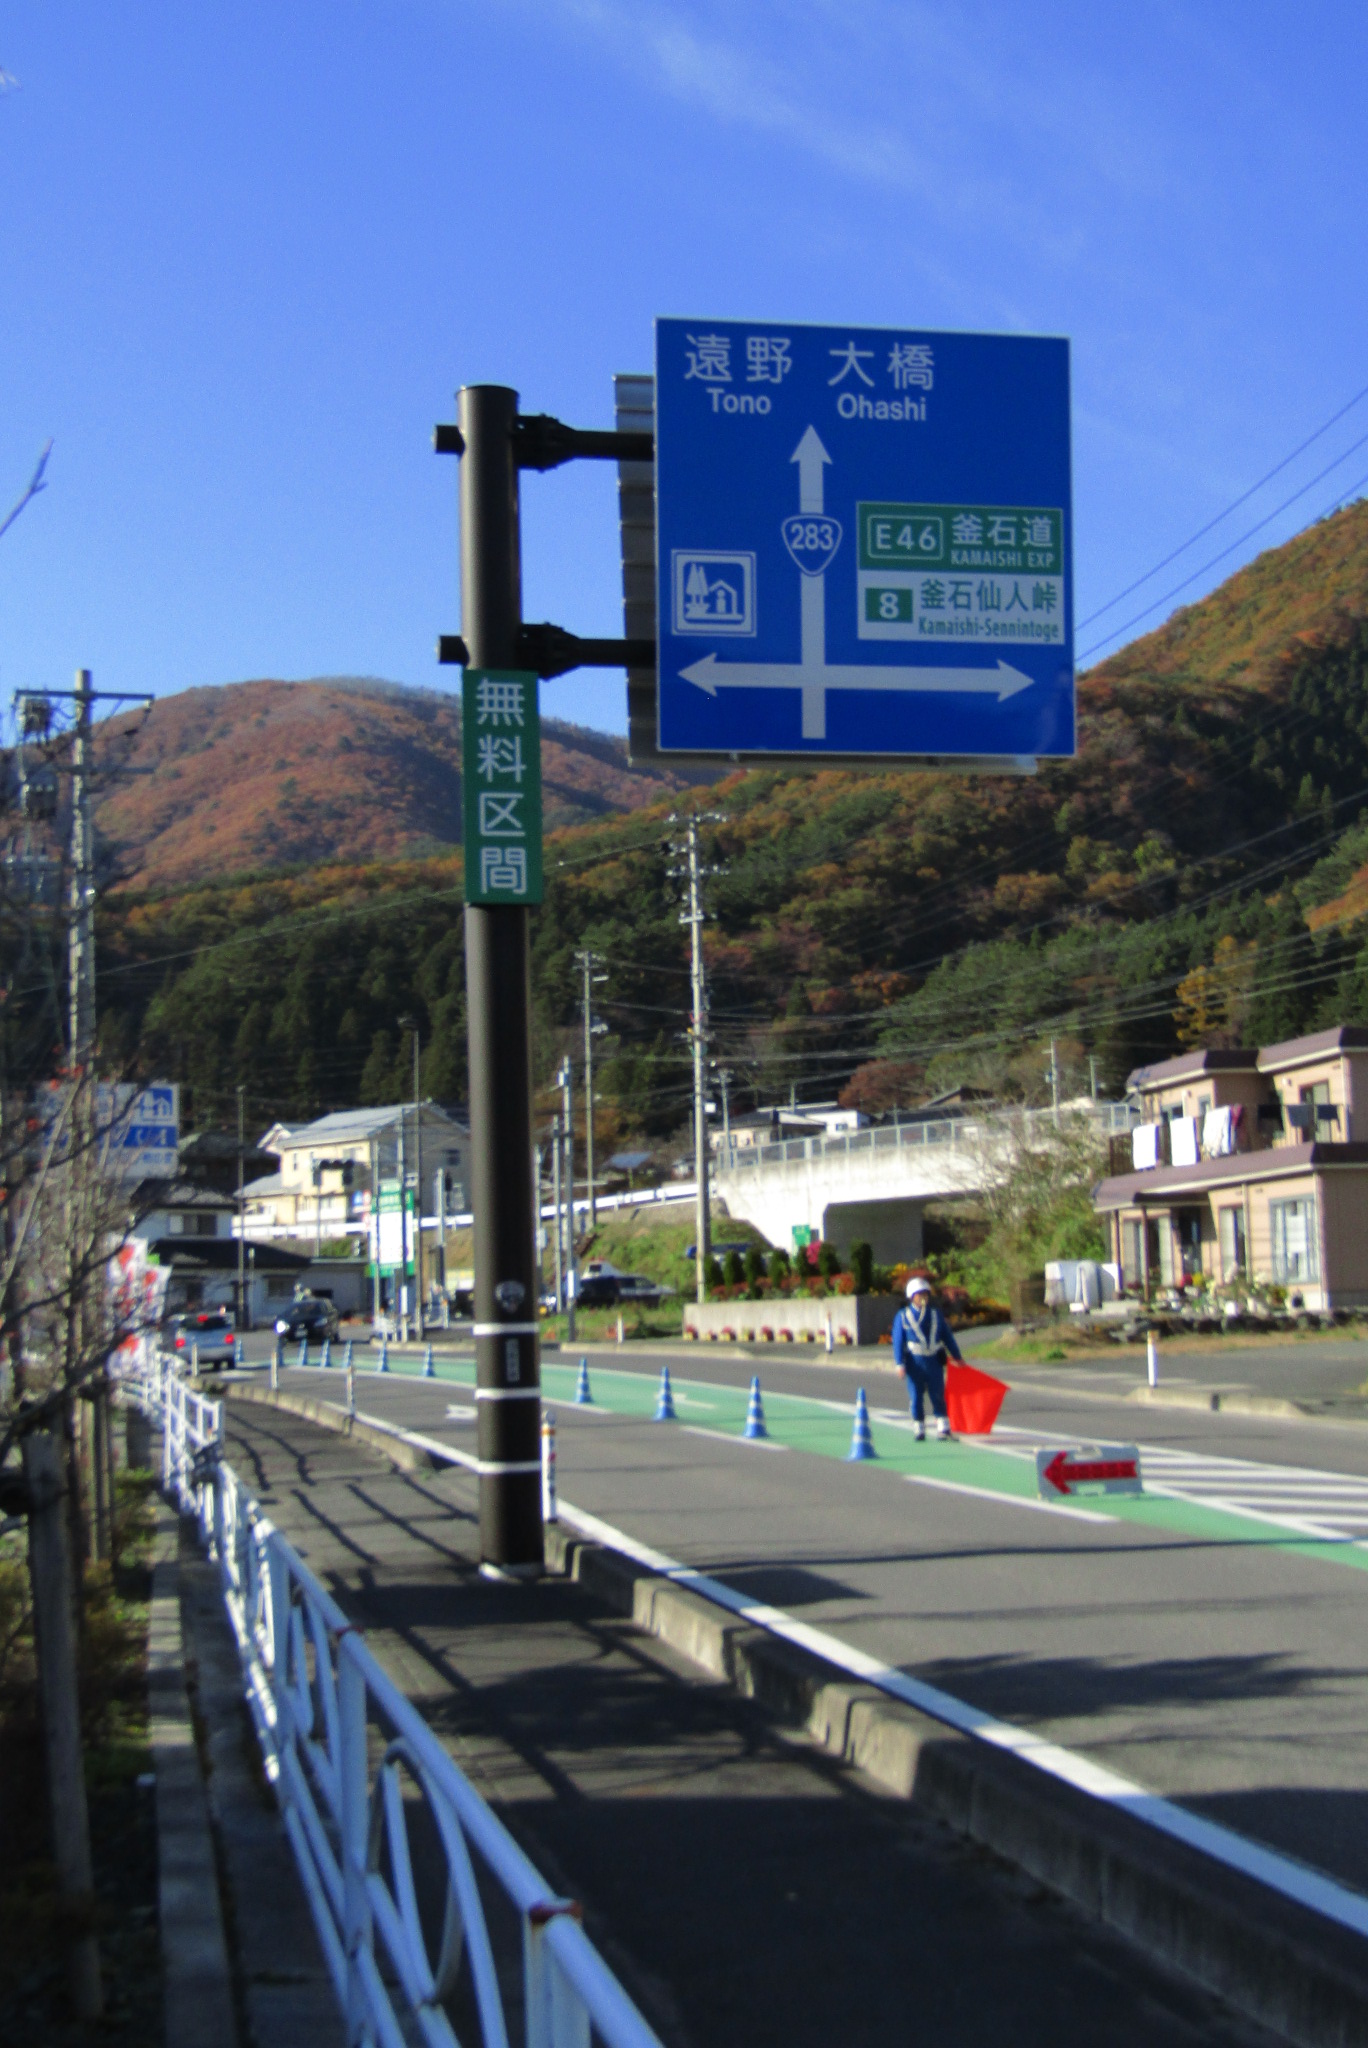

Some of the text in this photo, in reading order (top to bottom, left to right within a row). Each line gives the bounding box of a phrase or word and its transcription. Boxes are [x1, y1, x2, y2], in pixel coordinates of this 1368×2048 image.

[684, 333, 935, 391] 遠野 大橋
[706, 387, 927, 421] Tono Ohashi
[790, 523, 834, 551] 283
[876, 523, 937, 551] E46
[952, 513, 1054, 548] 釜石道
[951, 549, 1054, 568] KAMAISHI EXP
[879, 591, 900, 619] 8
[920, 579, 1058, 614] 釜石仙人峠
[919, 616, 1059, 642] Kamaishi-Sennintoge
[475, 677, 528, 896] 無料区間
